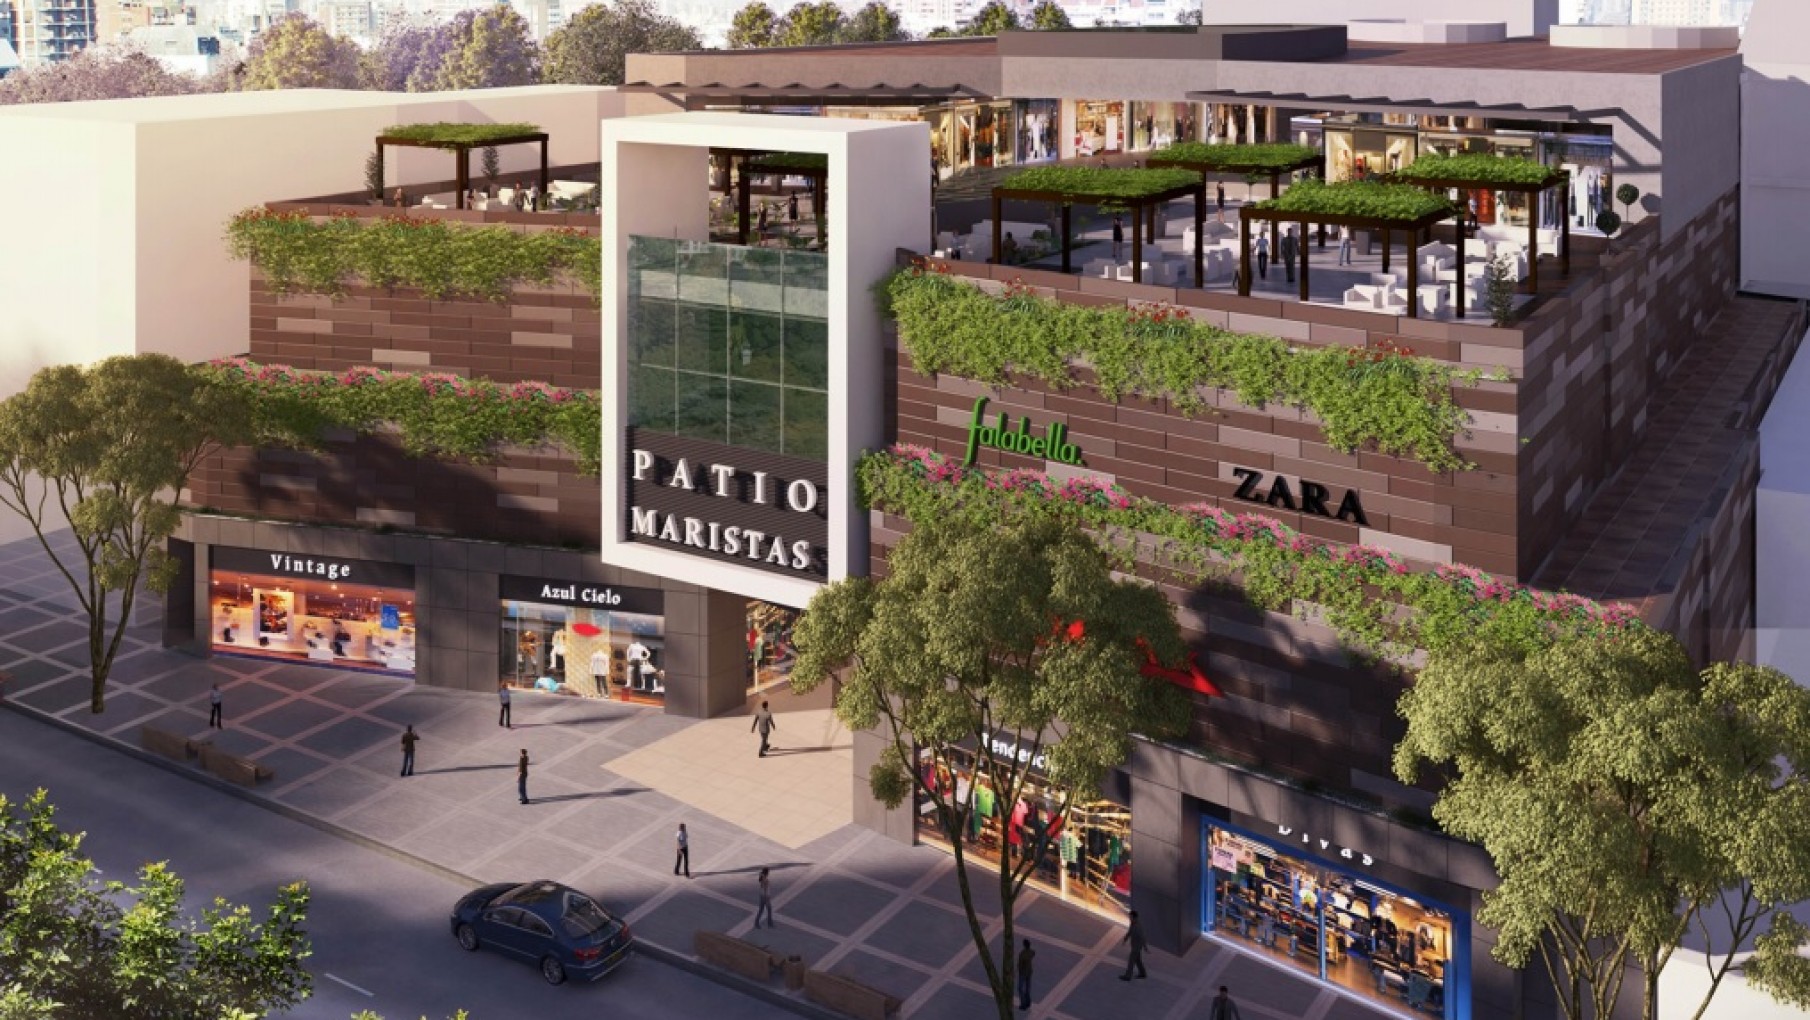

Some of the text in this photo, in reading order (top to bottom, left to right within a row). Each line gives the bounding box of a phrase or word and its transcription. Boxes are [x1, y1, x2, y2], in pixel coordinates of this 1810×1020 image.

[632, 449, 818, 512] PATIO
[1233, 466, 1371, 526] ZARA
[270, 553, 351, 580] Vintage
[631, 506, 811, 570] MARISTAS
[541, 584, 622, 605] Azul Cielo
